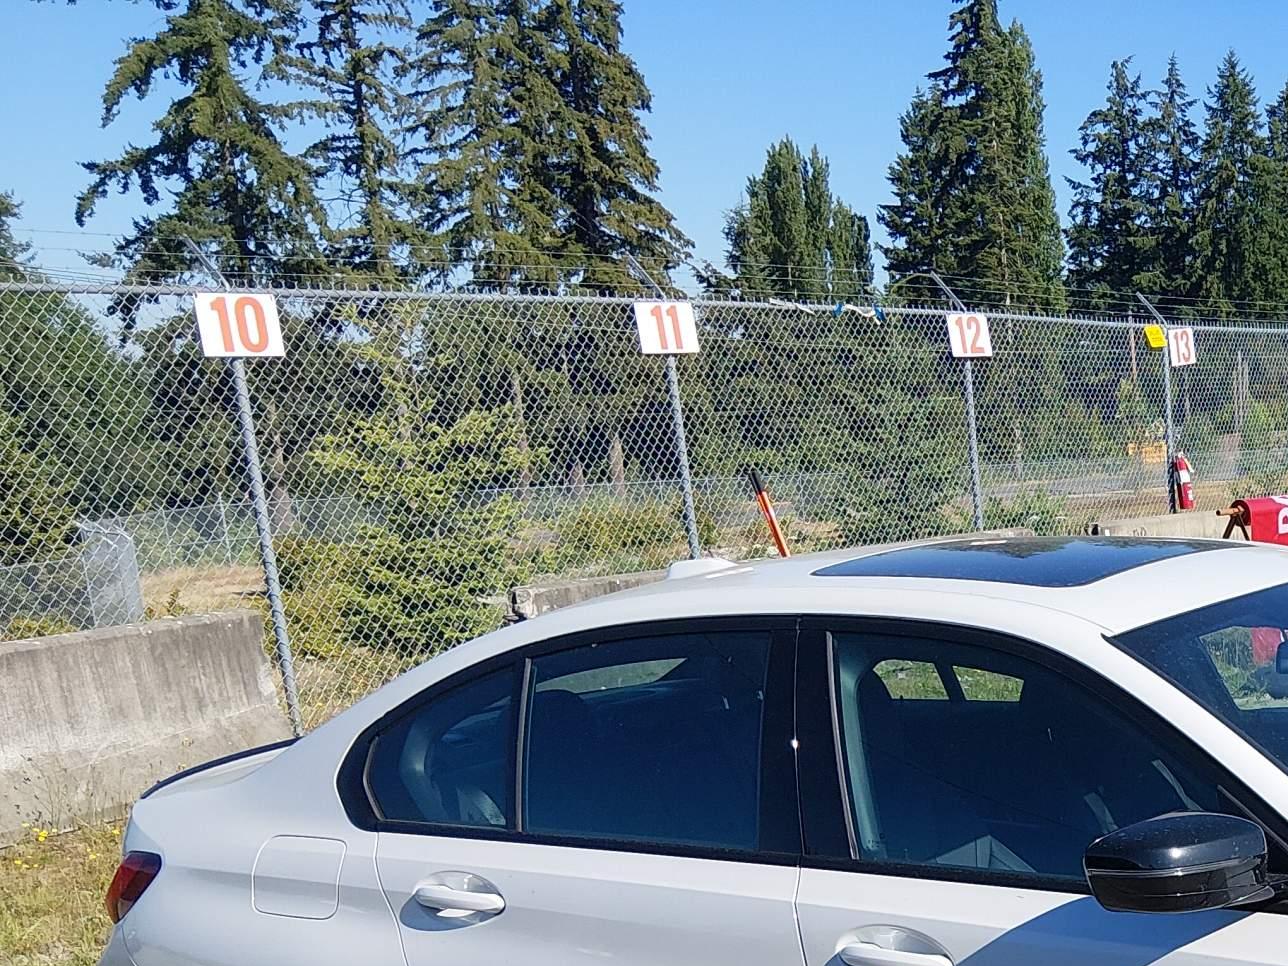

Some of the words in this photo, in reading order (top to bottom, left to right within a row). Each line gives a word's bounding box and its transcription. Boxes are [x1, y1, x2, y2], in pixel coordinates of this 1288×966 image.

[210, 296, 269, 353] 10
[650, 304, 684, 350] 11
[955, 316, 985, 354] 12
[1173, 330, 1191, 363] 13
